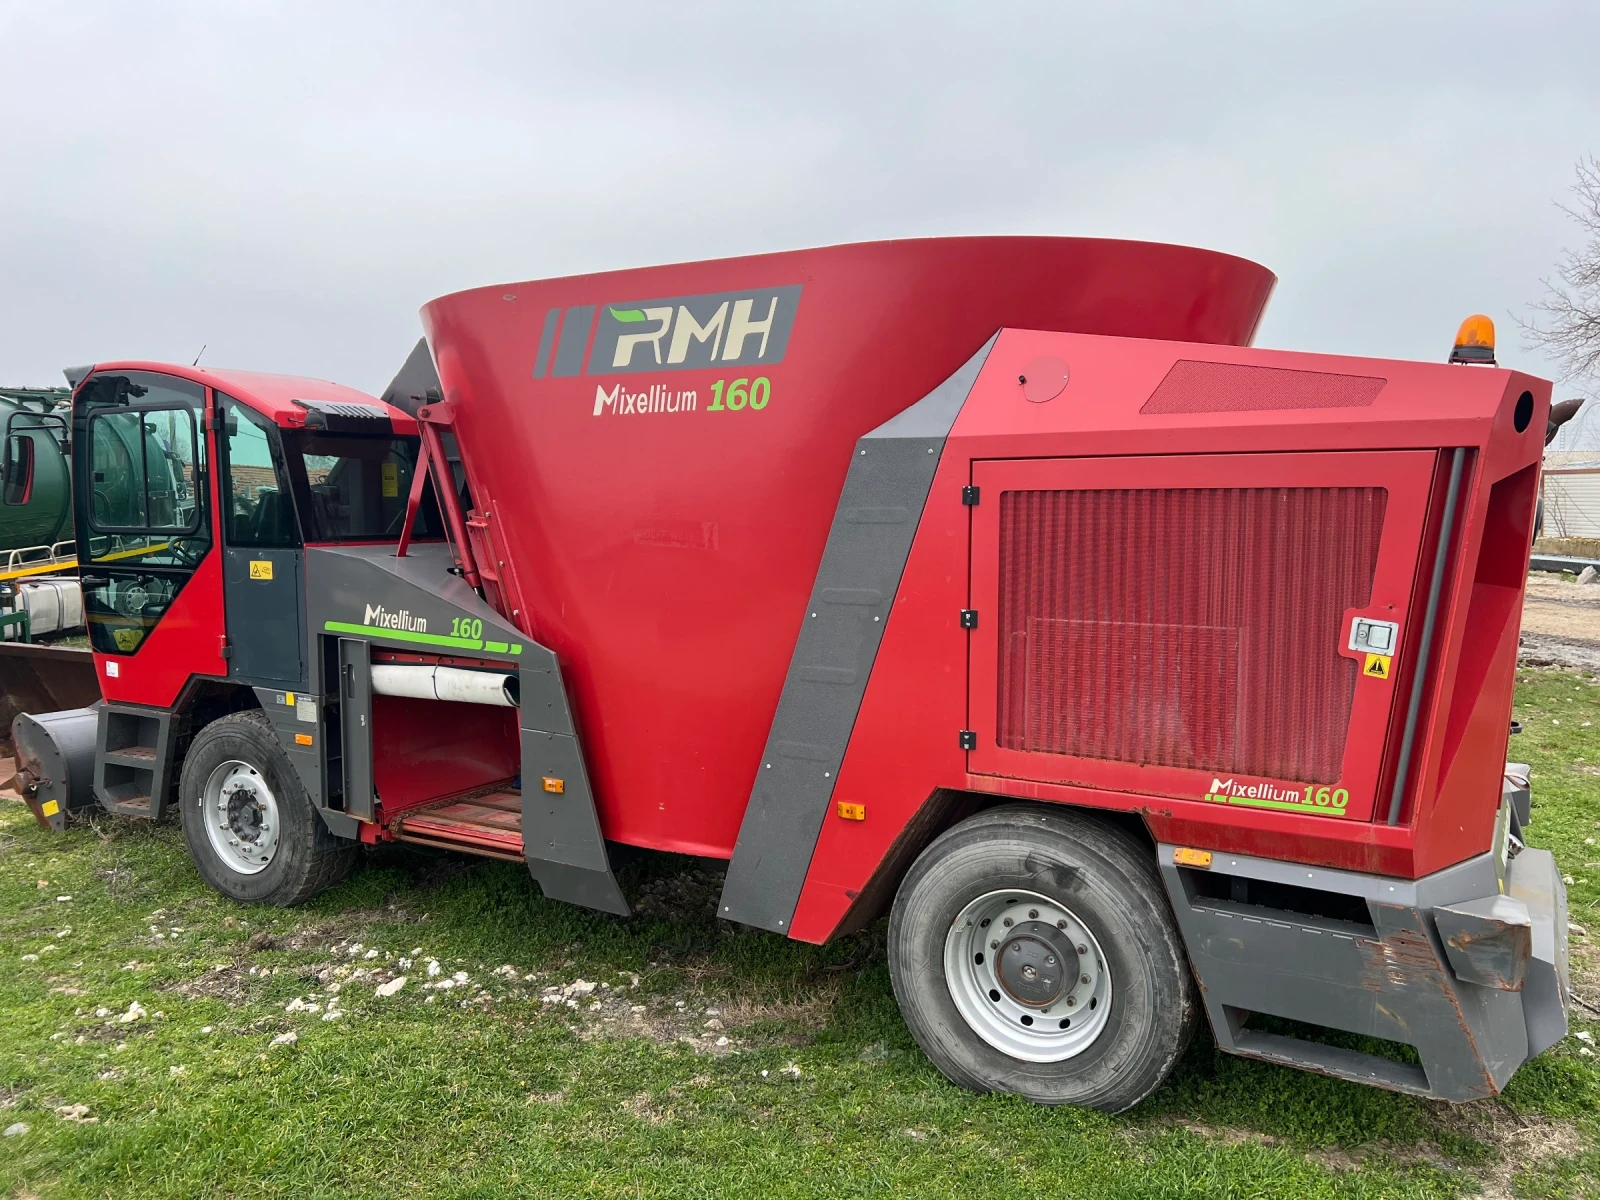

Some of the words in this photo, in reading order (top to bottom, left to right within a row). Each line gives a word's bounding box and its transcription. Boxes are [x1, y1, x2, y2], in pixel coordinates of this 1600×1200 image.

[609, 297, 778, 367] RMH
[593, 384, 697, 416] Mixellium
[706, 377, 771, 411] 160
[364, 604, 427, 632] Mixellium
[450, 617, 483, 640] 160
[1210, 778, 1299, 803] Mixellium
[1301, 786, 1349, 808] 160
